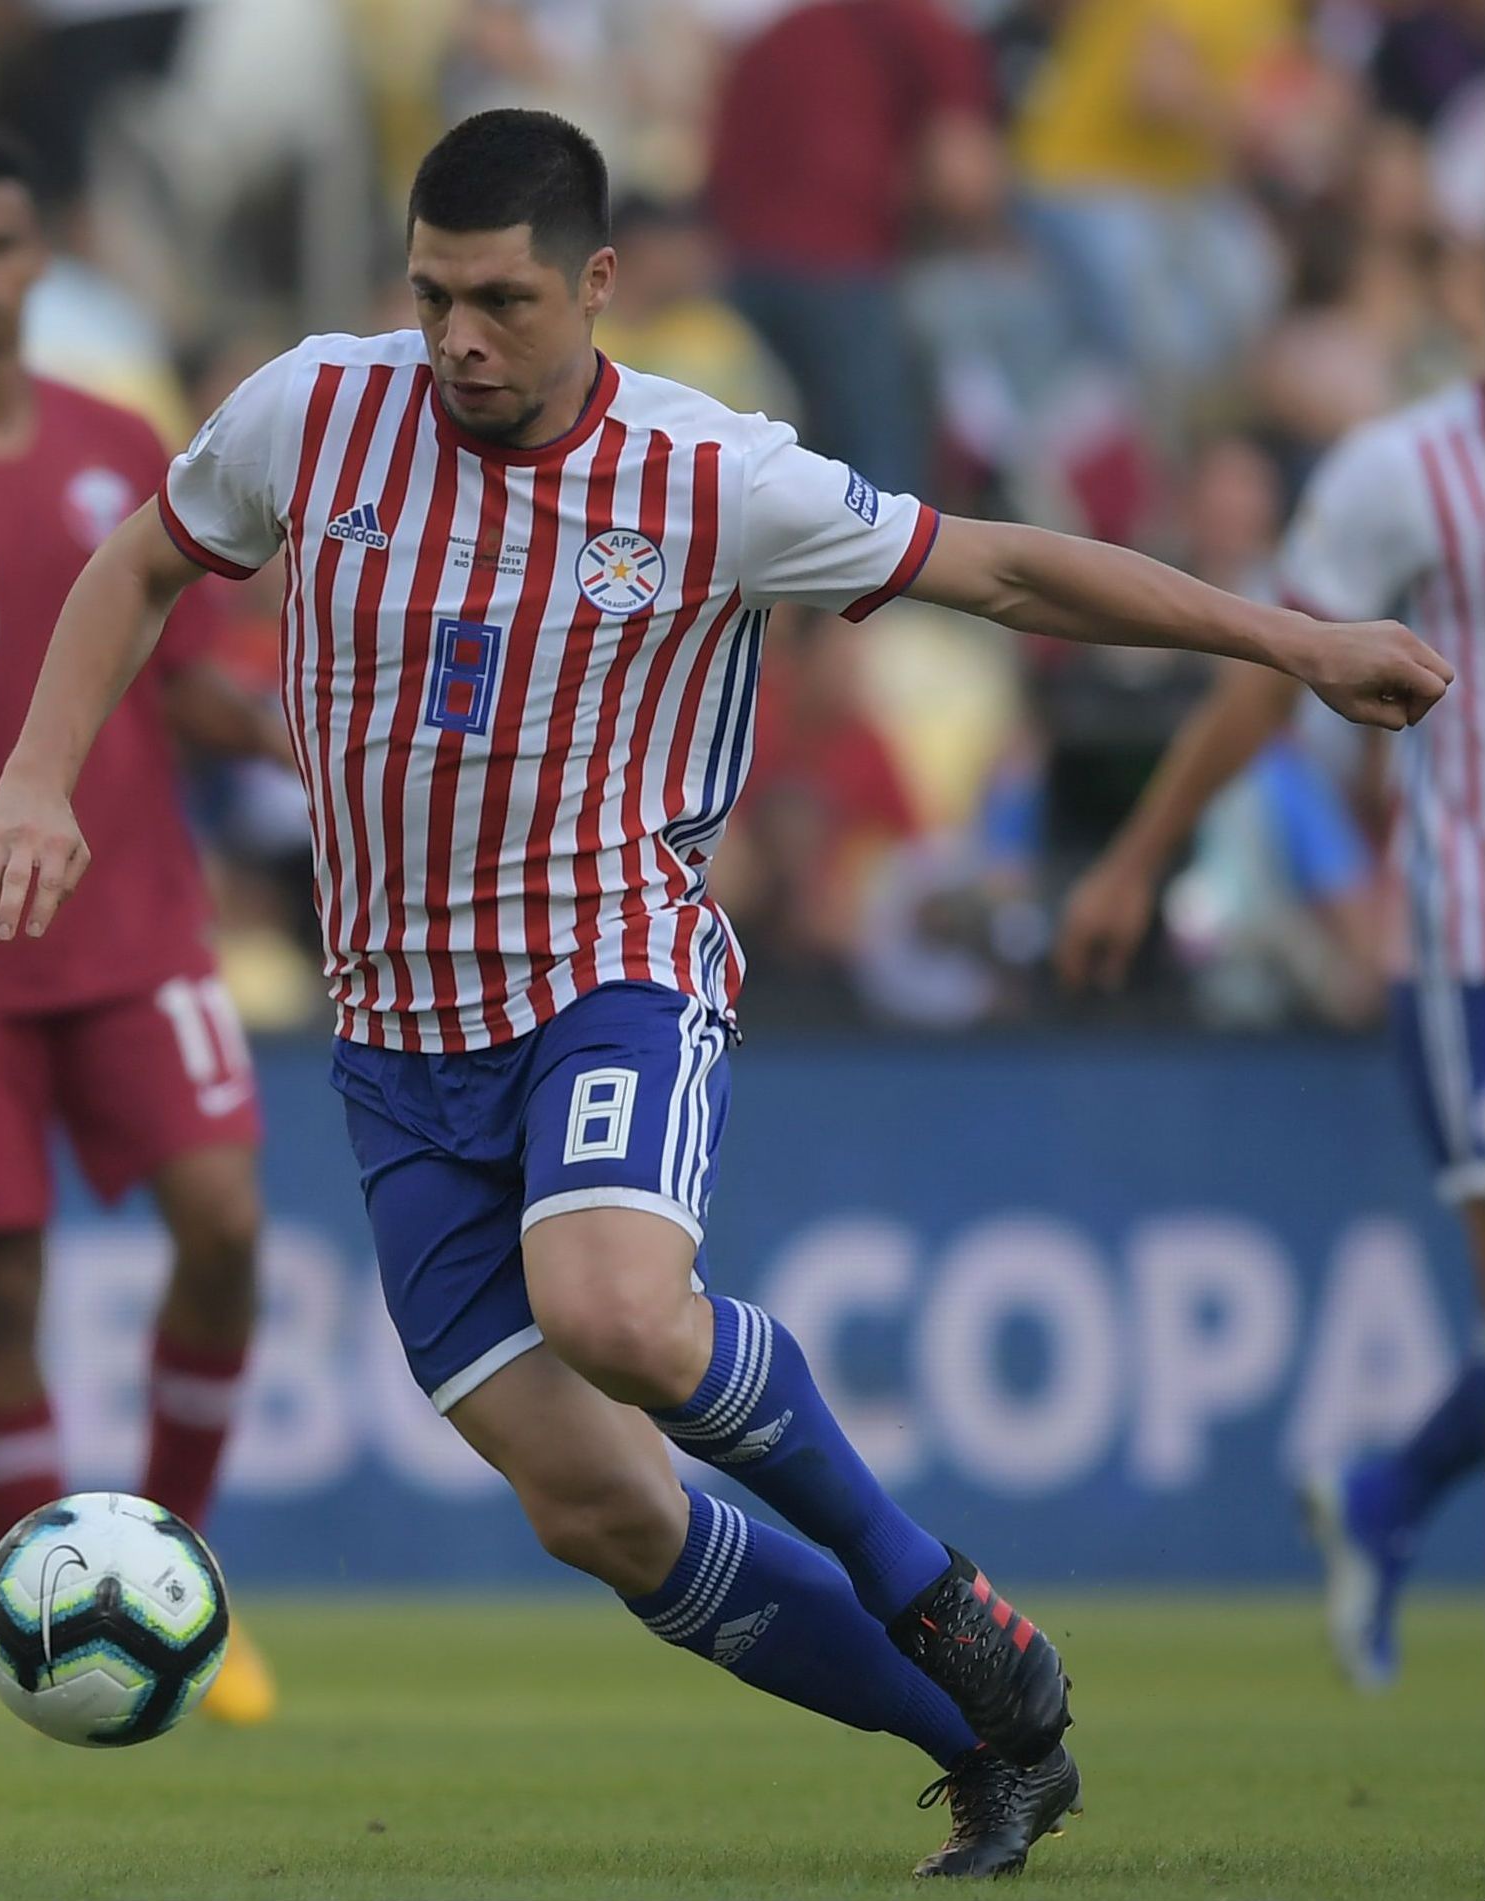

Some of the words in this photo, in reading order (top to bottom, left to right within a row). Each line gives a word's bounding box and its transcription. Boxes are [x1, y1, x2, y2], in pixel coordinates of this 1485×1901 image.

[328, 522, 386, 549] adidas
[453, 559, 470, 569] RIO
[609, 535, 641, 550] APF
[423, 618, 504, 737] 8
[563, 1067, 639, 1165] 8
[756, 1211, 1461, 1498] COPA
